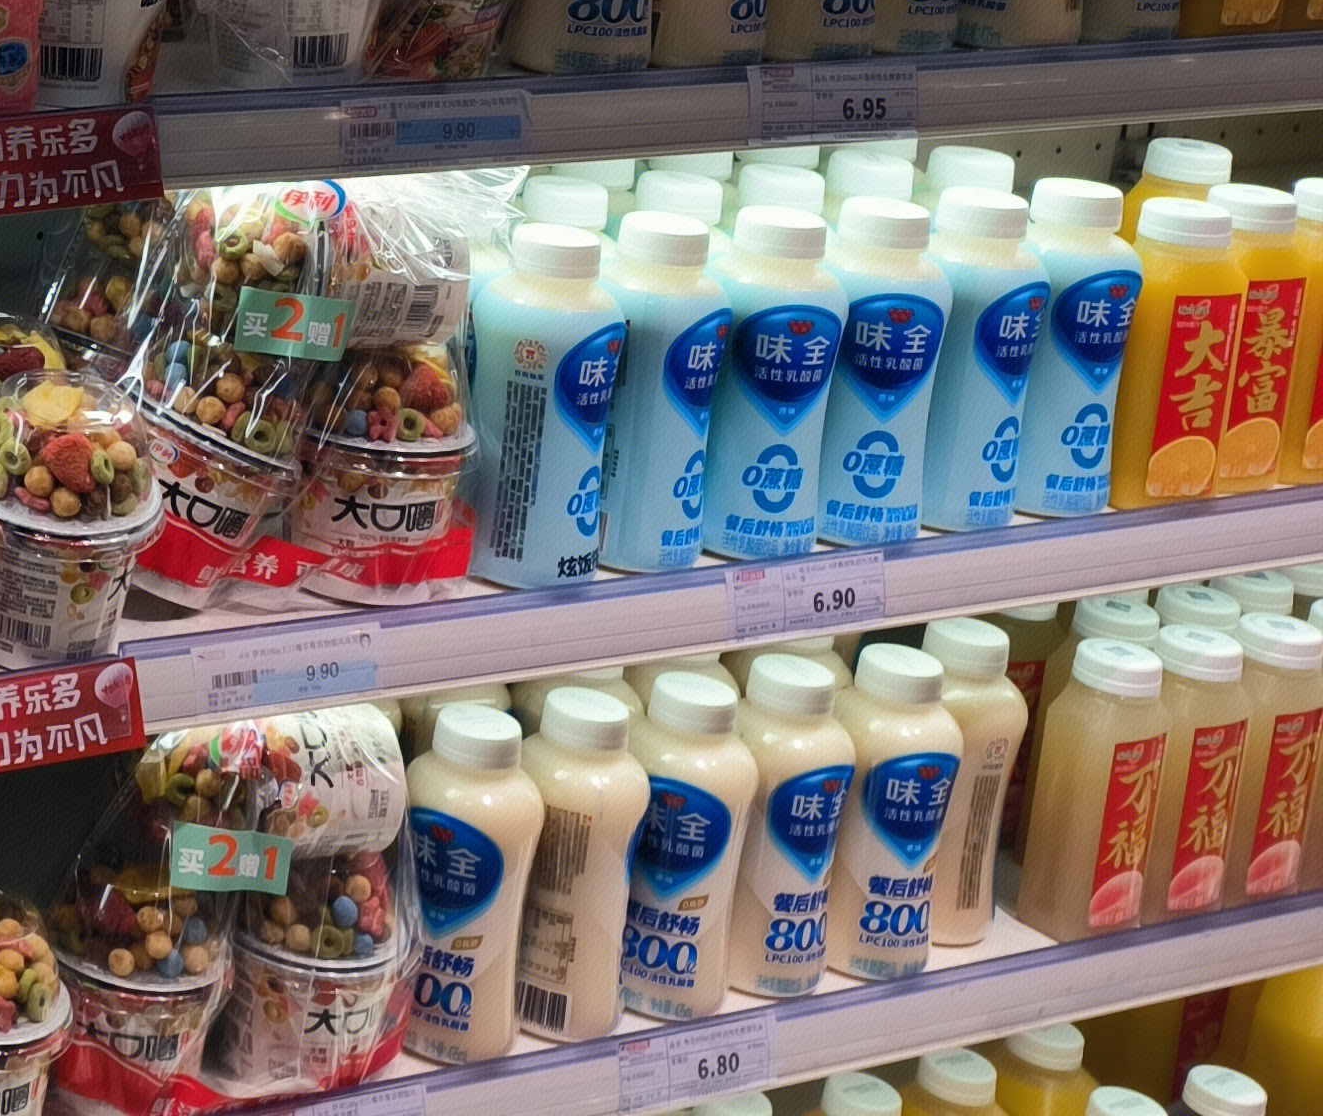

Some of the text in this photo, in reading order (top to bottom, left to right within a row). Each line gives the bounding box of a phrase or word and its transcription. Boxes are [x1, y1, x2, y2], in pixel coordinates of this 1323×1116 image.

[842, 98, 887, 122] 6.95
[443, 122, 476, 140] 9.90
[754, 334, 826, 367] 味全
[854, 324, 932, 355] 味全
[853, 352, 923, 371] 活性乳酸菌
[1172, 319, 1226, 430] 大吉
[1237, 306, 1295, 415] 暴富
[842, 448, 905, 480] 0蔗糖
[813, 587, 857, 615] 6.90
[305, 661, 340, 681] 9.90
[697, 1052, 741, 1081] 6.80
